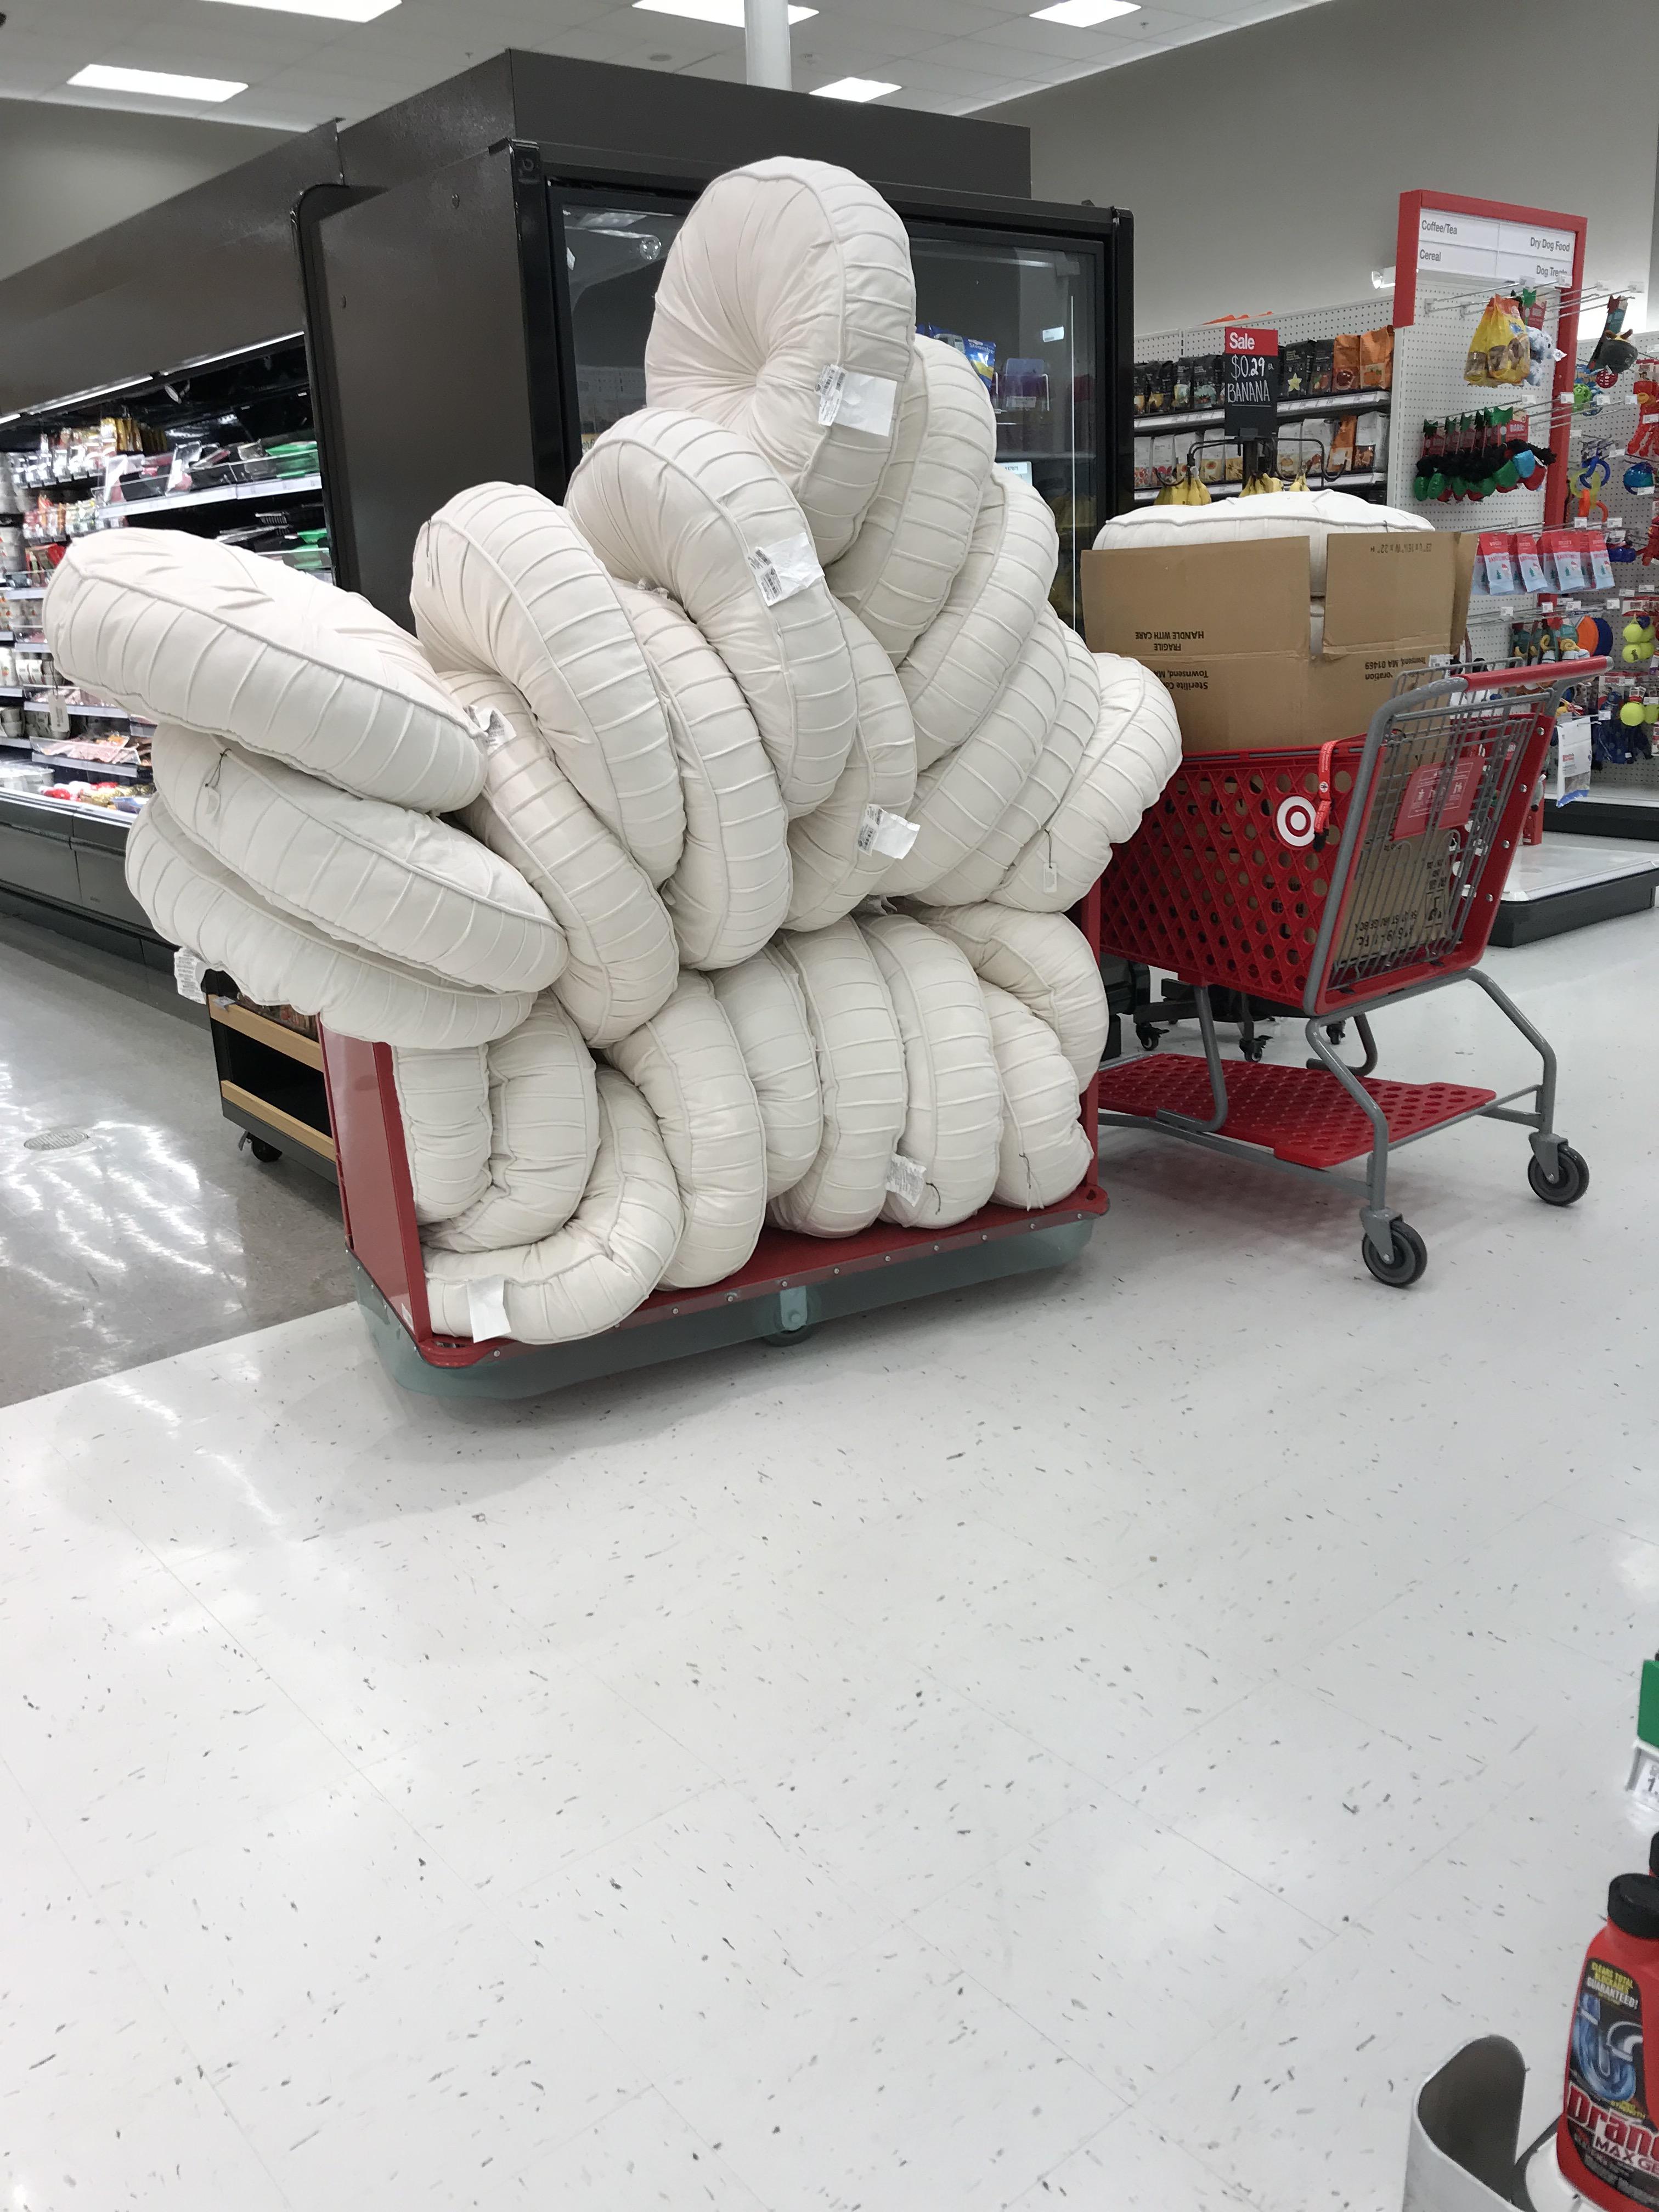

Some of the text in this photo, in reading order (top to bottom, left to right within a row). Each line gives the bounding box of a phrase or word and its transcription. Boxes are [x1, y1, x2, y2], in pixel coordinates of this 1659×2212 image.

[1421, 220, 1457, 235] Coffee/Tea
[1530, 237, 1570, 252] Dry Dog Food
[1420, 249, 1441, 262] Cereal
[1536, 265, 1548, 278] Dog
[1229, 332, 1255, 349] Sale
[1231, 354, 1265, 381] $0.29
[1227, 380, 1270, 403] BANANA
[1135, 631, 1204, 640] HANDLE WITH CARE
[1154, 643, 1181, 651] FRAGILE
[1365, 661, 1386, 670] 01469
[1167, 670, 1208, 678] Townsend,
[1365, 672, 1393, 681] oration
[1176, 682, 1208, 690] Sterilite
[1587, 1977, 1638, 2010] GUARANTEED!
[1596, 2136, 1634, 2164] MAX
